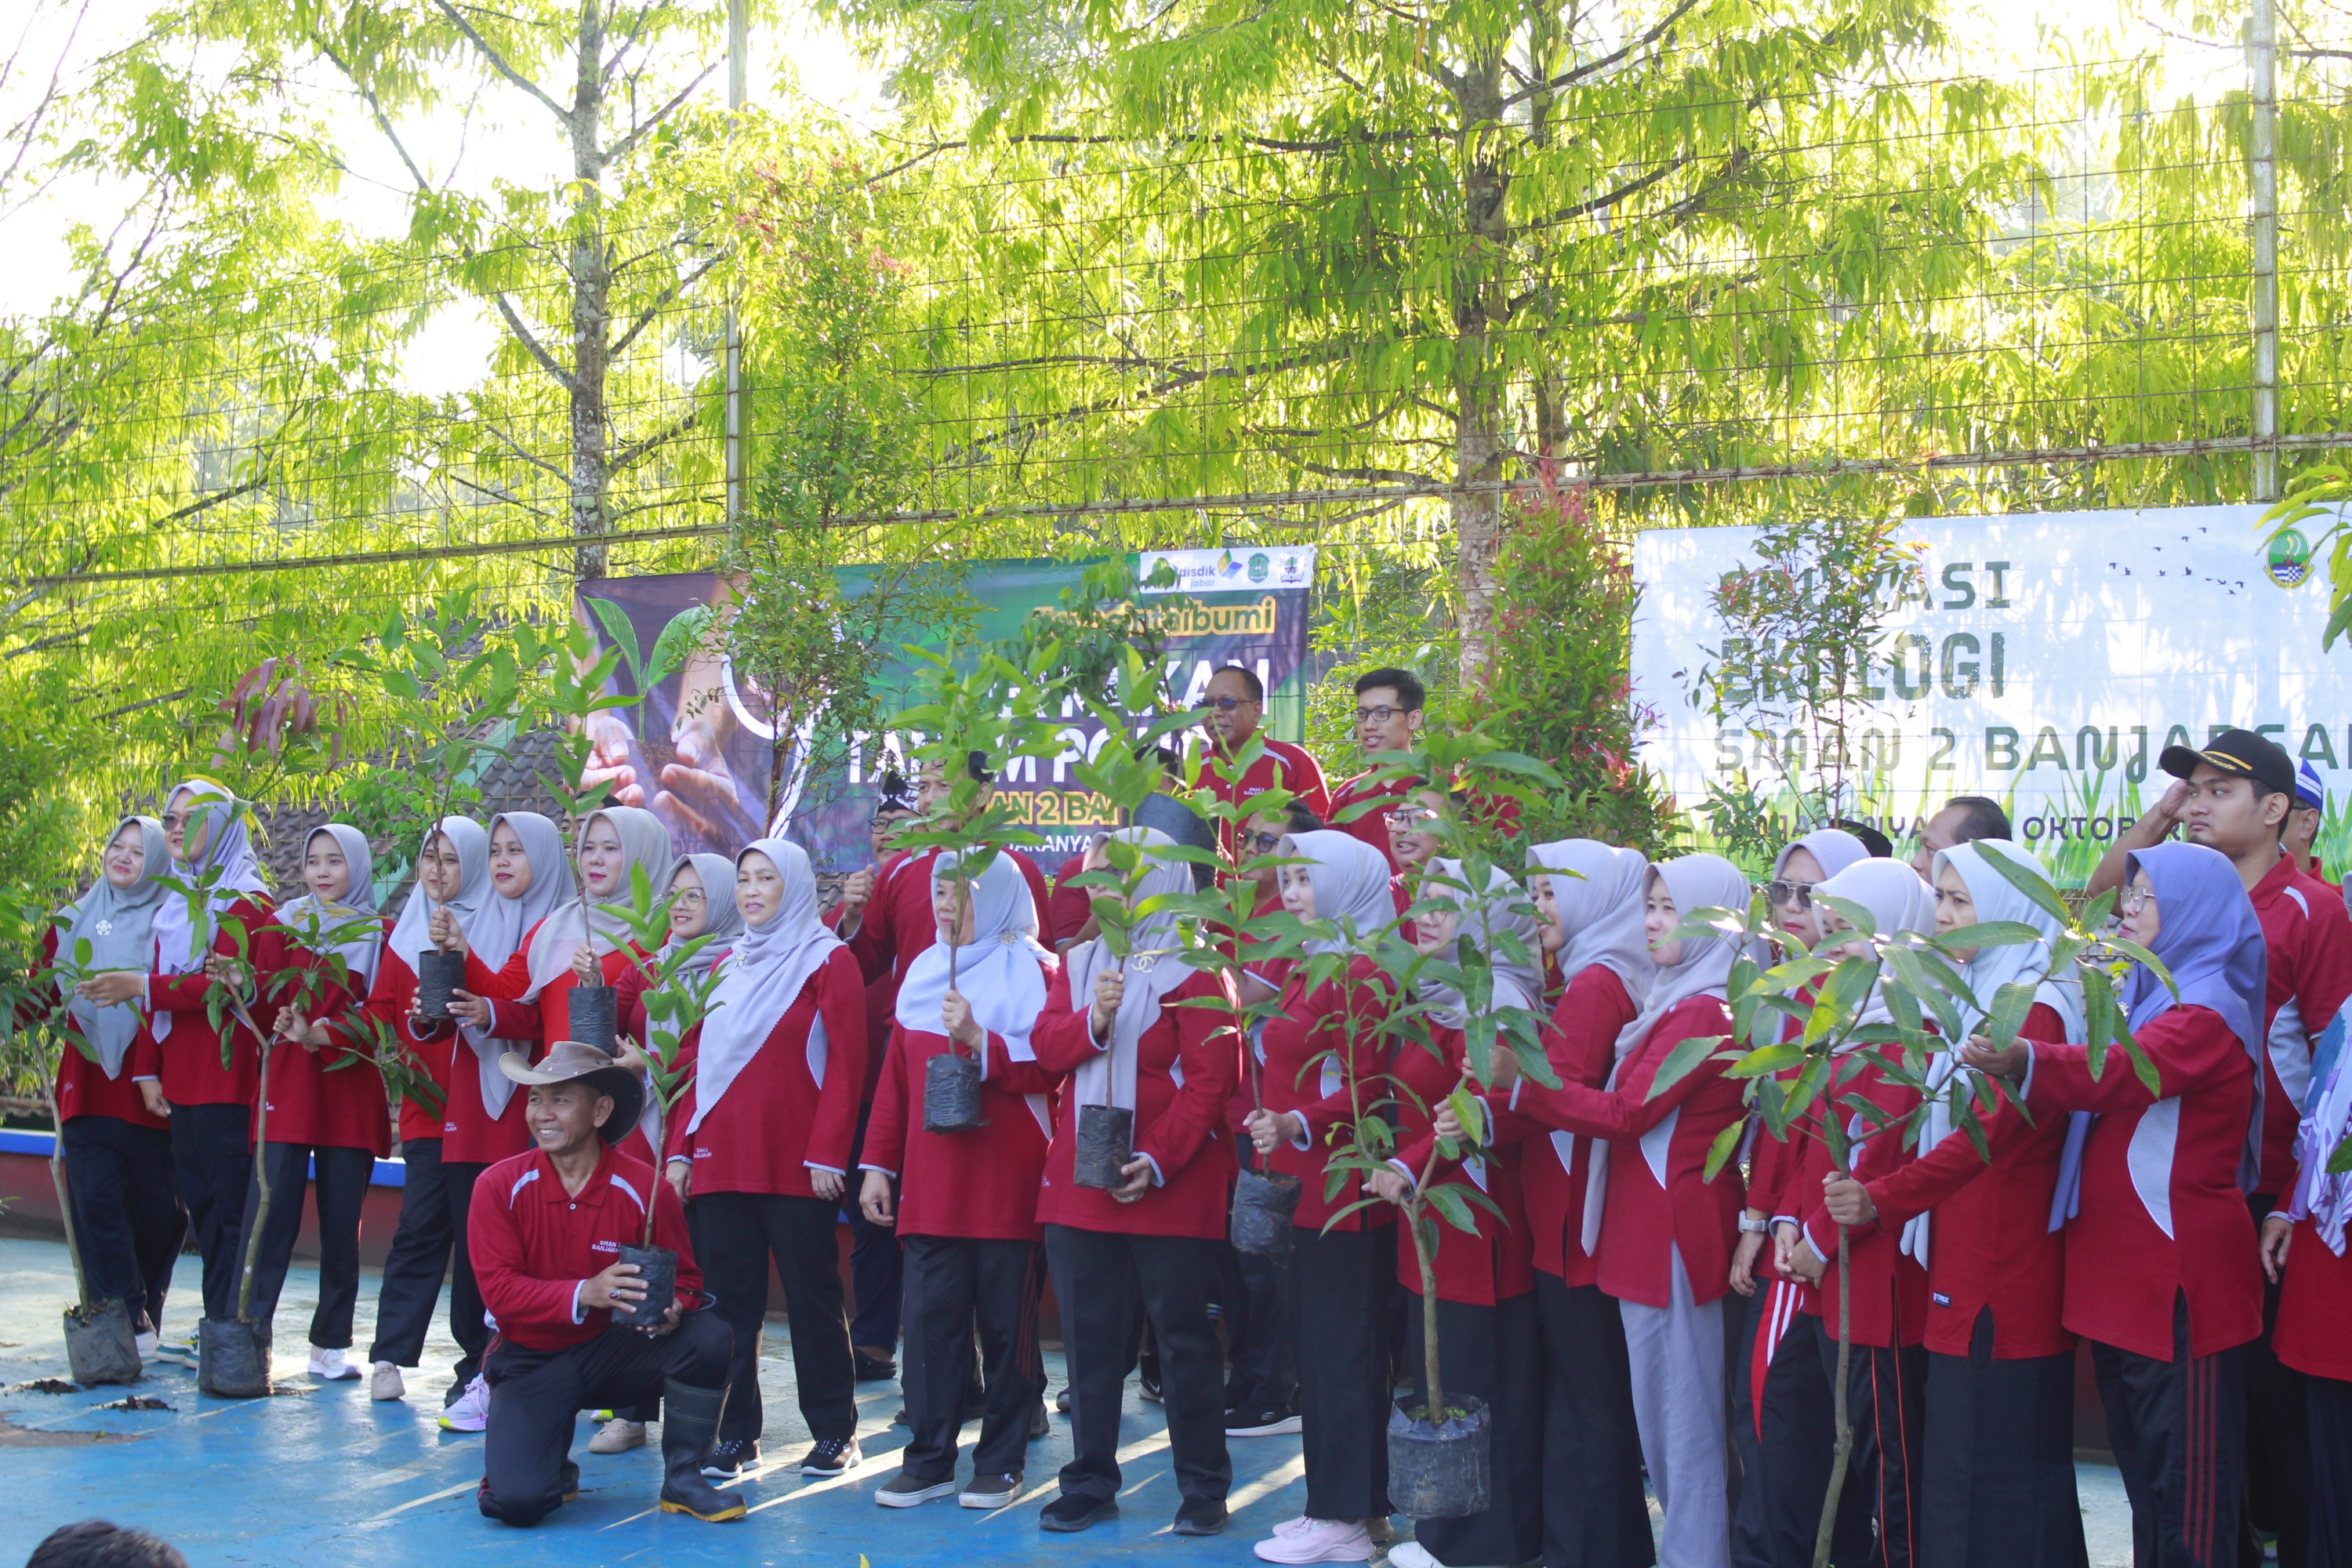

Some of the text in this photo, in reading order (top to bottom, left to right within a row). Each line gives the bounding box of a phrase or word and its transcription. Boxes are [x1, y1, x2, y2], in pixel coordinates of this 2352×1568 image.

[1179, 565, 1215, 577] disdik
[1190, 579, 1215, 590] jabar
[1714, 727, 1901, 771] SMAN
[1928, 727, 1956, 771] 2
[1035, 791, 1061, 825] 2
